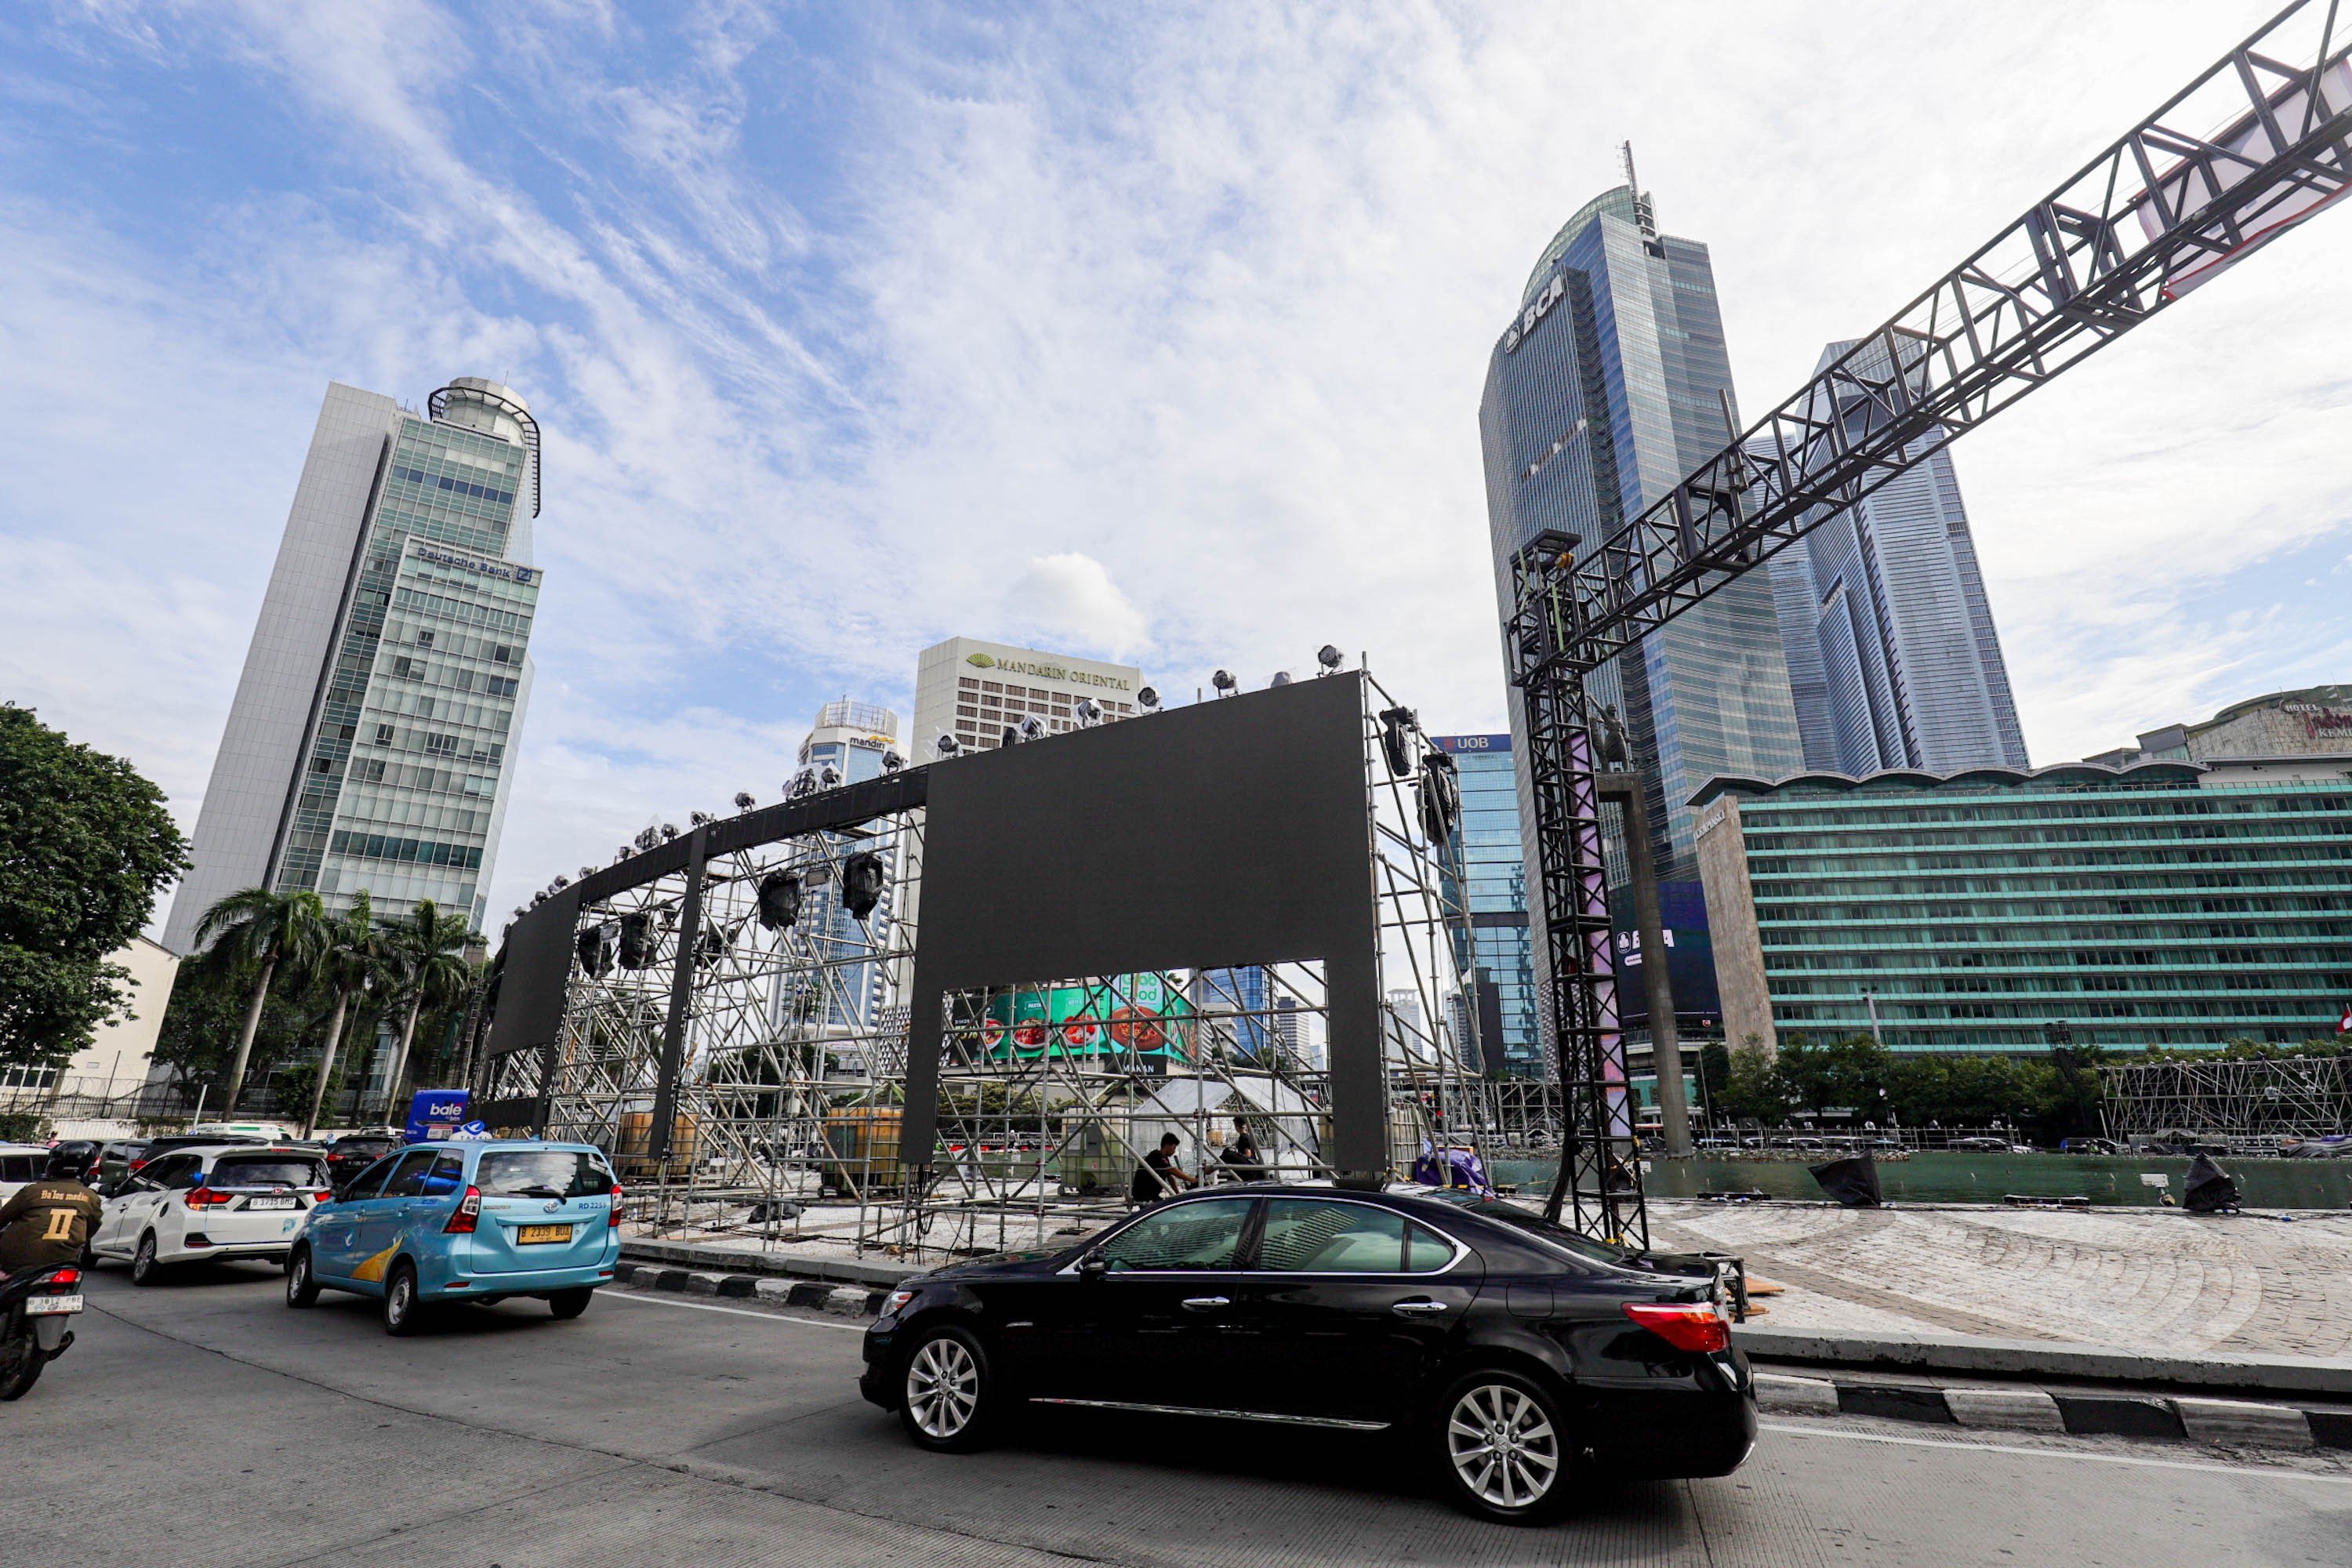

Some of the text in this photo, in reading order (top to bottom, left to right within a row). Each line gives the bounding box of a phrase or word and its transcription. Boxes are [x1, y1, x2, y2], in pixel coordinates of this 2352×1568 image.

[1523, 274, 1563, 336] BCA
[417, 547, 510, 578] Deutsche Bank
[996, 658, 1130, 691] MANDARIN ORIENTAL
[850, 736, 885, 750] mandiri
[1457, 737, 1489, 749] UOB
[1632, 929, 1675, 949] BA
[1122, 972, 1157, 986] Gab
[1122, 987, 1157, 1001] Fod
[430, 1103, 462, 1115] bale
[521, 1229, 527, 1237] B
